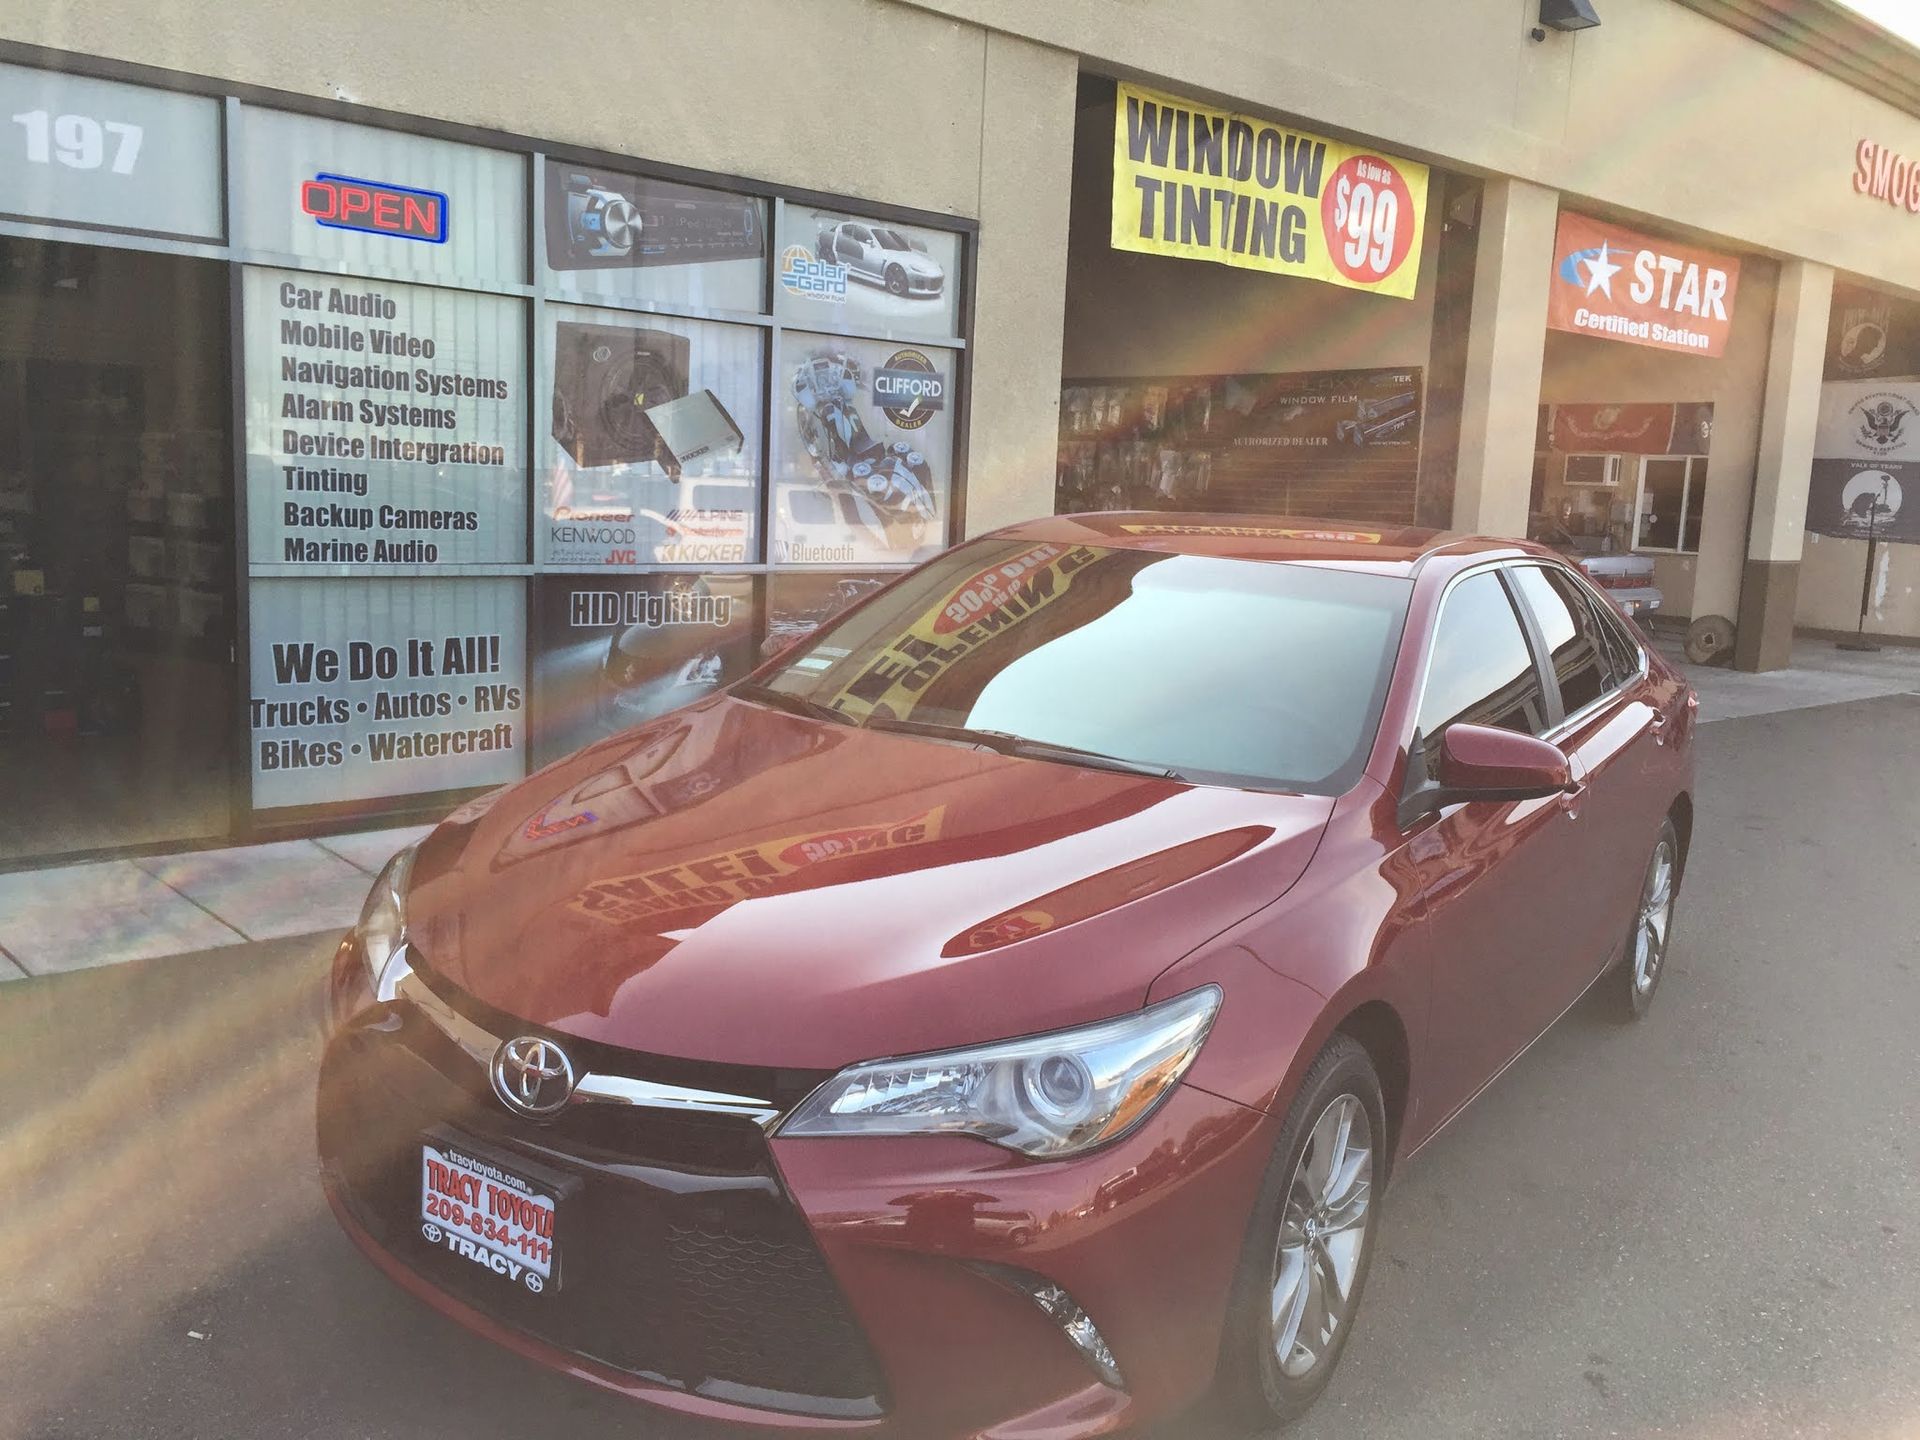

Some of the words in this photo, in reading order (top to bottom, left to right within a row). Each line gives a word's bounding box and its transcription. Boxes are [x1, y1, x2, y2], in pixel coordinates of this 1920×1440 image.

[12, 110, 143, 174] 197
[1126, 96, 1327, 199] WINDOW
[1356, 159, 1367, 178] As
[1367, 162, 1382, 182] low
[1853, 139, 1920, 213] SMOG
[302, 180, 437, 235] OPEN
[1135, 175, 1305, 264] TINTING
[1334, 173, 1398, 274] $99
[793, 258, 846, 279] Solar
[798, 275, 846, 295] Gard
[1630, 249, 1727, 321] STAR
[279, 282, 322, 312] Car
[328, 287, 396, 320] Audio
[280, 319, 364, 353] Mobile
[370, 328, 435, 359] Video
[1574, 308, 1649, 339] Certified
[1652, 322, 1709, 349] Station
[281, 356, 409, 392] Navigation
[414, 368, 507, 400] Systems
[875, 376, 942, 397] CLIFFORD
[1393, 375, 1412, 383] TEK
[282, 393, 353, 422] Alarm
[359, 401, 456, 430] Systems
[1280, 397, 1326, 405] WINDOW
[1331, 395, 1358, 404] FILM
[282, 429, 364, 459] Device
[371, 434, 505, 466] Intergration
[282, 465, 368, 496] Tinting
[283, 502, 373, 530] Backup
[379, 504, 478, 531] Cameras
[552, 506, 635, 523] Pioneer
[692, 509, 744, 521] ALPINE
[284, 538, 368, 563] Marine
[373, 539, 438, 563] Audio
[551, 527, 635, 544] KENWOOD
[679, 544, 744, 561] KICKER
[791, 543, 854, 561] Bluetooth
[605, 550, 636, 565] JVC
[570, 591, 620, 627] HID
[627, 590, 732, 629] Lighting
[272, 642, 339, 684] We
[348, 641, 398, 682] Do
[407, 639, 435, 678] It
[442, 635, 500, 675] All!
[251, 697, 350, 728] Trucks
[374, 691, 452, 721] Autos
[474, 684, 521, 712] RVs
[260, 740, 343, 770] Bikes
[368, 724, 512, 762] Watercraft
[449, 1149, 526, 1191] tracytoyota.com
[427, 1159, 482, 1208] TRACY
[487, 1184, 555, 1238] TOYOTA
[427, 1193, 551, 1264] 209-834-111
[446, 1232, 523, 1281] TRACY
